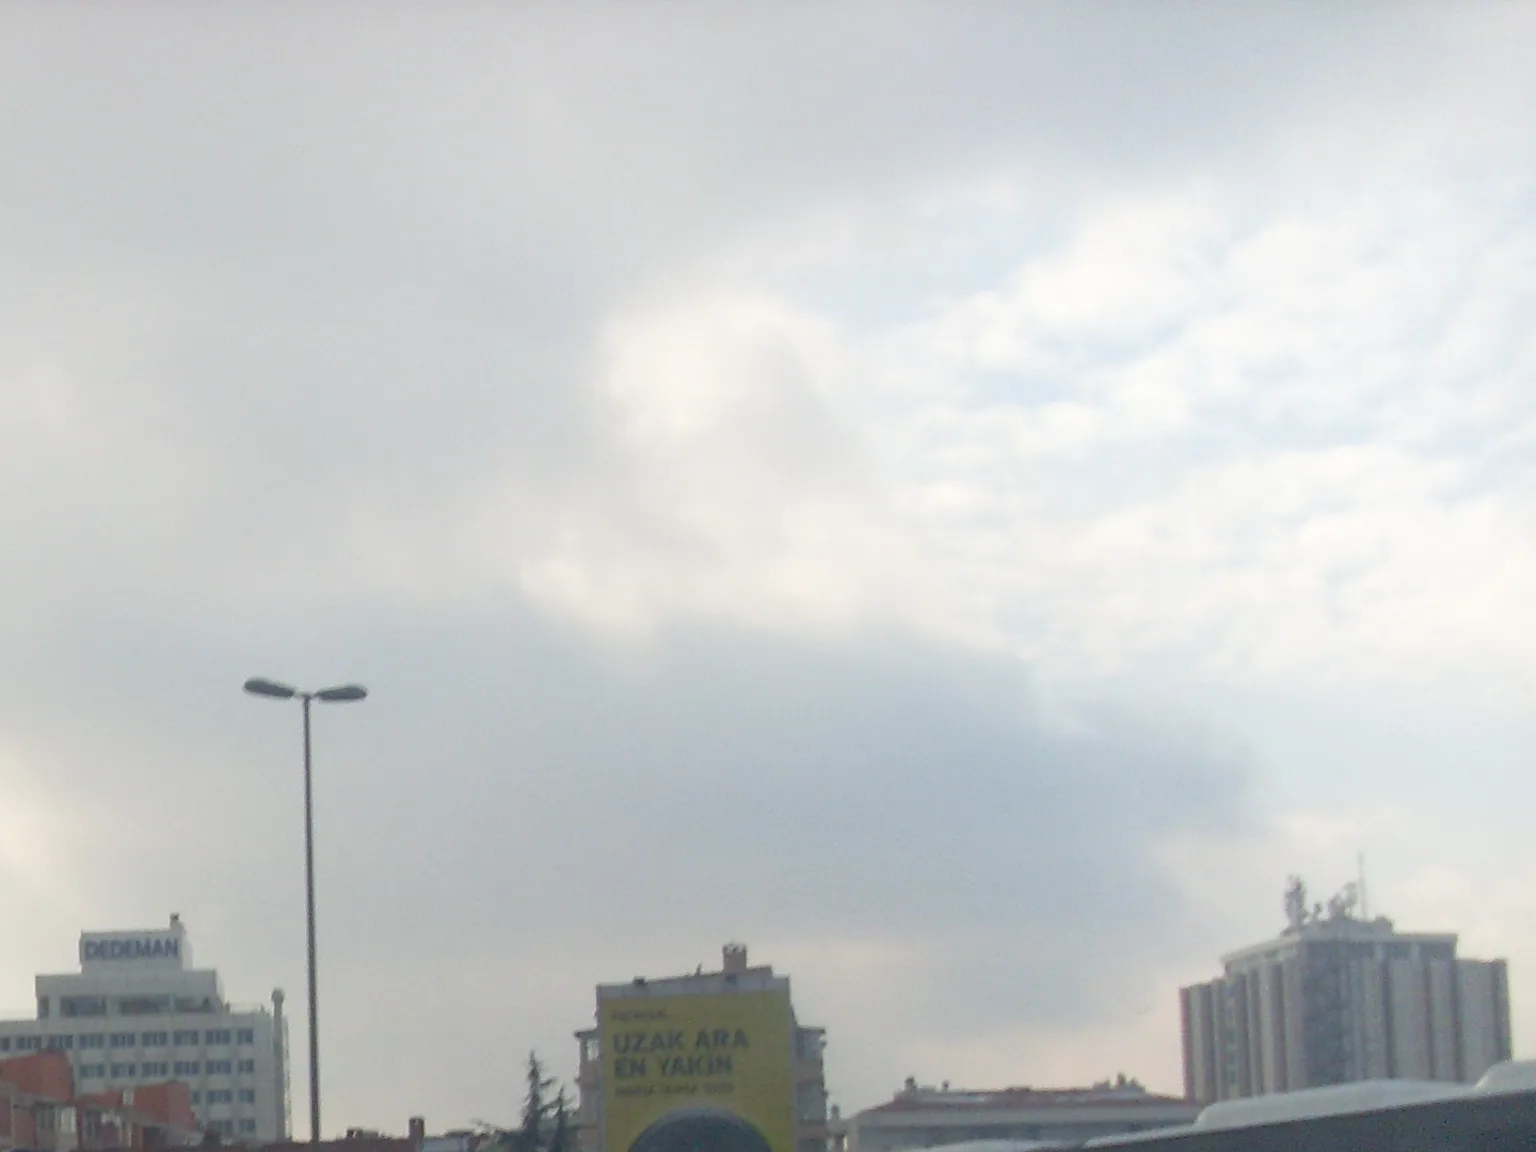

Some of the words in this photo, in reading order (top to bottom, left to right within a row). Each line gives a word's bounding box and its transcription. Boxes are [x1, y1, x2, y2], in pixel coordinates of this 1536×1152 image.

[83, 936, 180, 961] DEDEMAN
[613, 1029, 686, 1055] UZAK
[695, 1027, 751, 1050] ARA
[614, 1055, 647, 1079] EN
